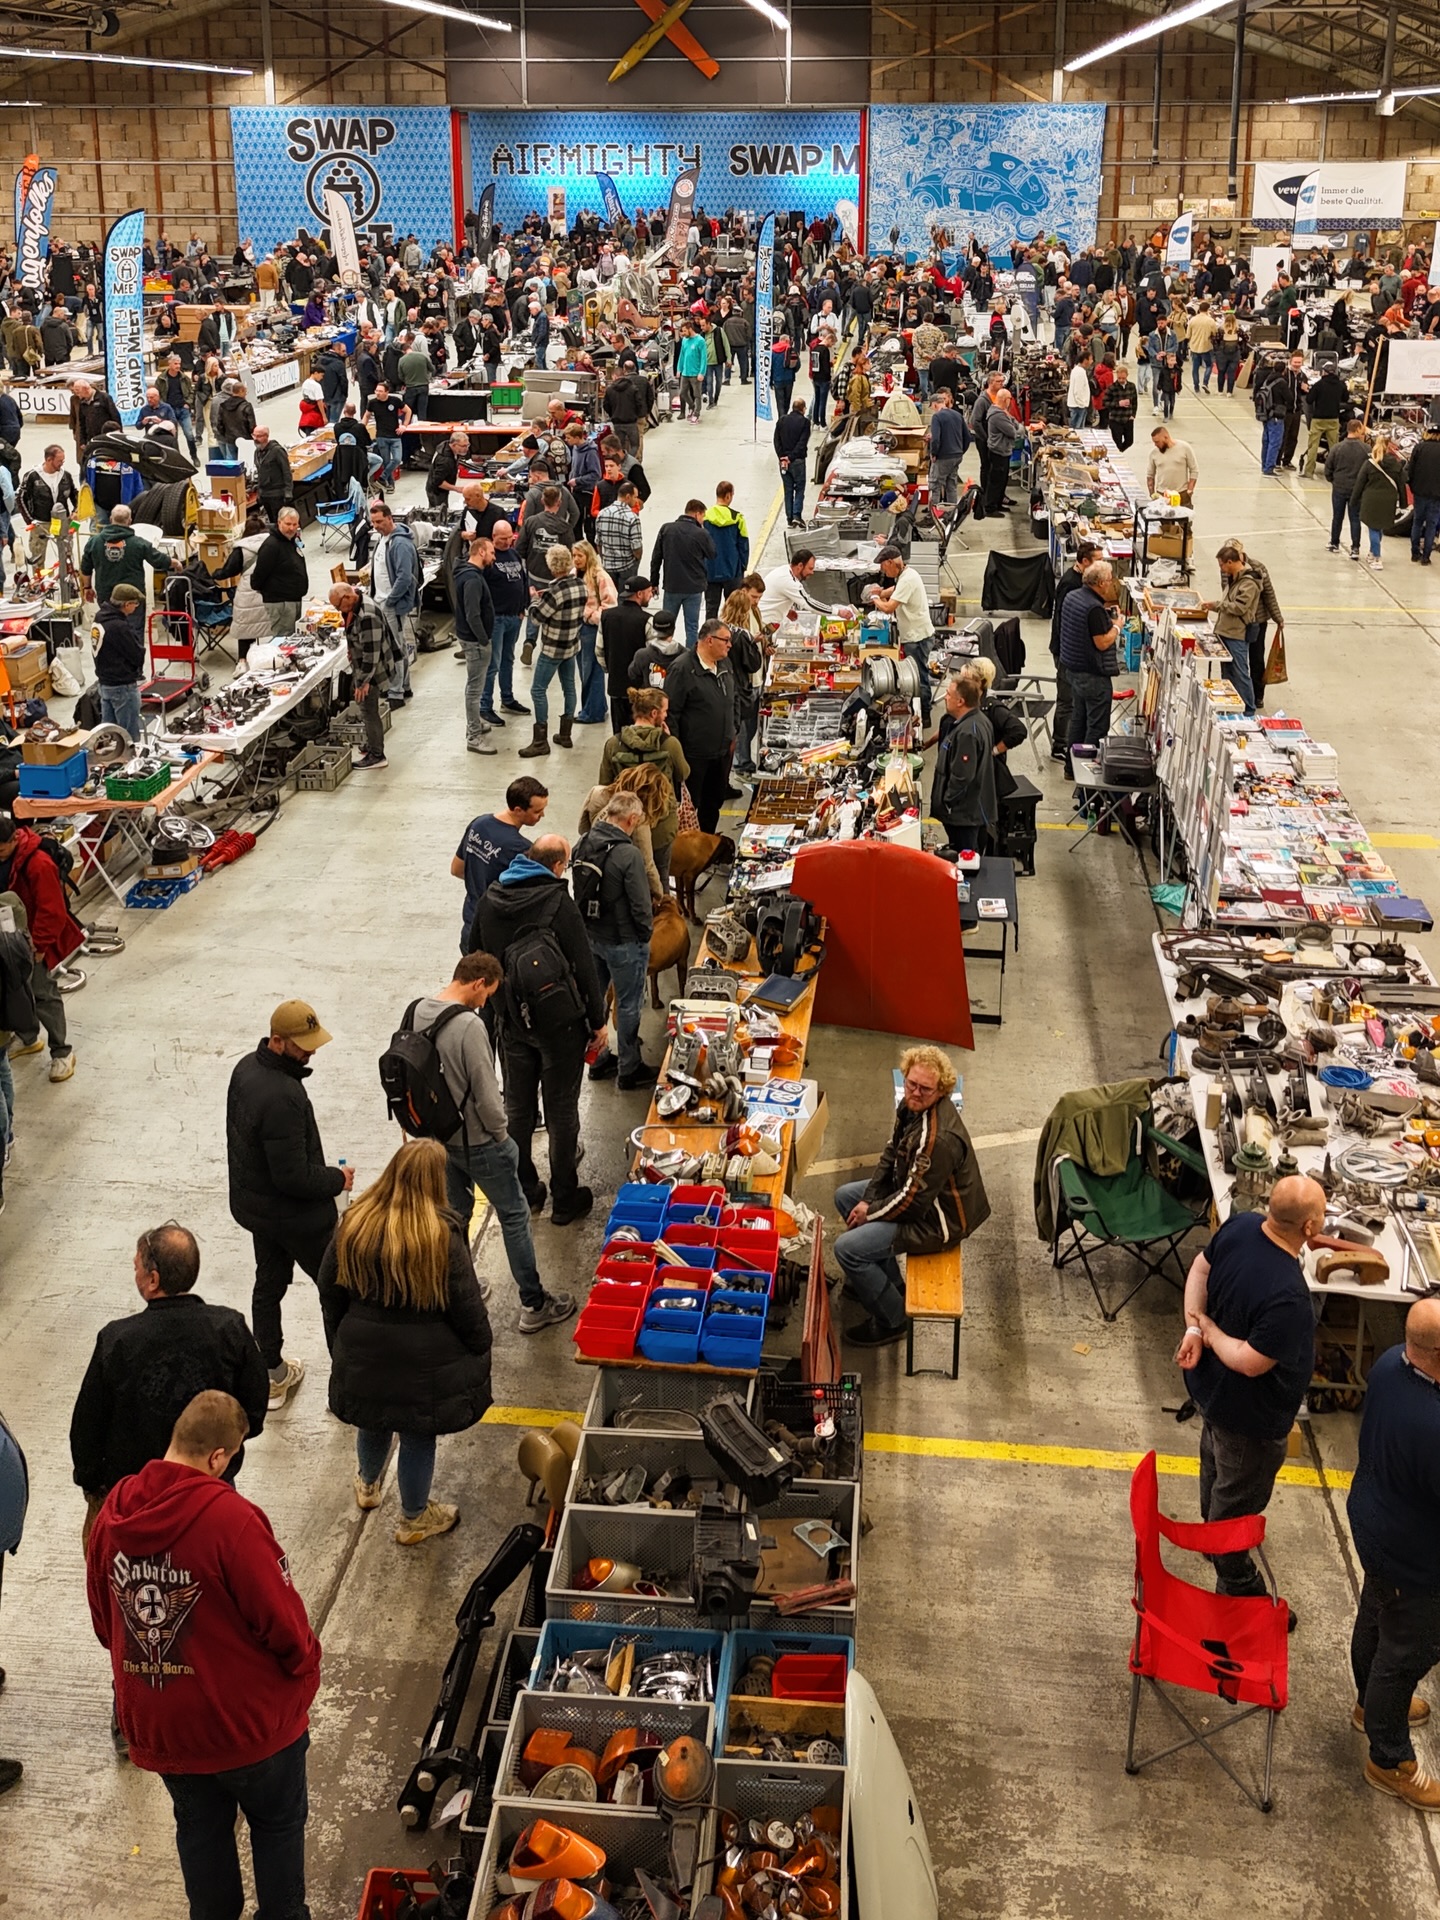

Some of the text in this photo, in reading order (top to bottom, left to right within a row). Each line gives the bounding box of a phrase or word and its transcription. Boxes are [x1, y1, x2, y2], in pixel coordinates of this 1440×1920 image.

[287, 118, 395, 162] SWAP
[492, 143, 860, 175] AIRMIGHTY SWAP M
[1278, 186, 1299, 195] vew
[1320, 197, 1343, 205] beste
[1350, 186, 1364, 194] die
[22, 171, 54, 303] agenfolks
[298, 224, 393, 253] MET
[111, 247, 141, 262] SWAP
[128, 309, 145, 408] SWAP MEET
[253, 363, 298, 393] usMarkt.NL
[18, 390, 71, 412] BusM
[113, 1550, 192, 1588] Sabaton
[122, 1659, 195, 1676] The Red Baron
